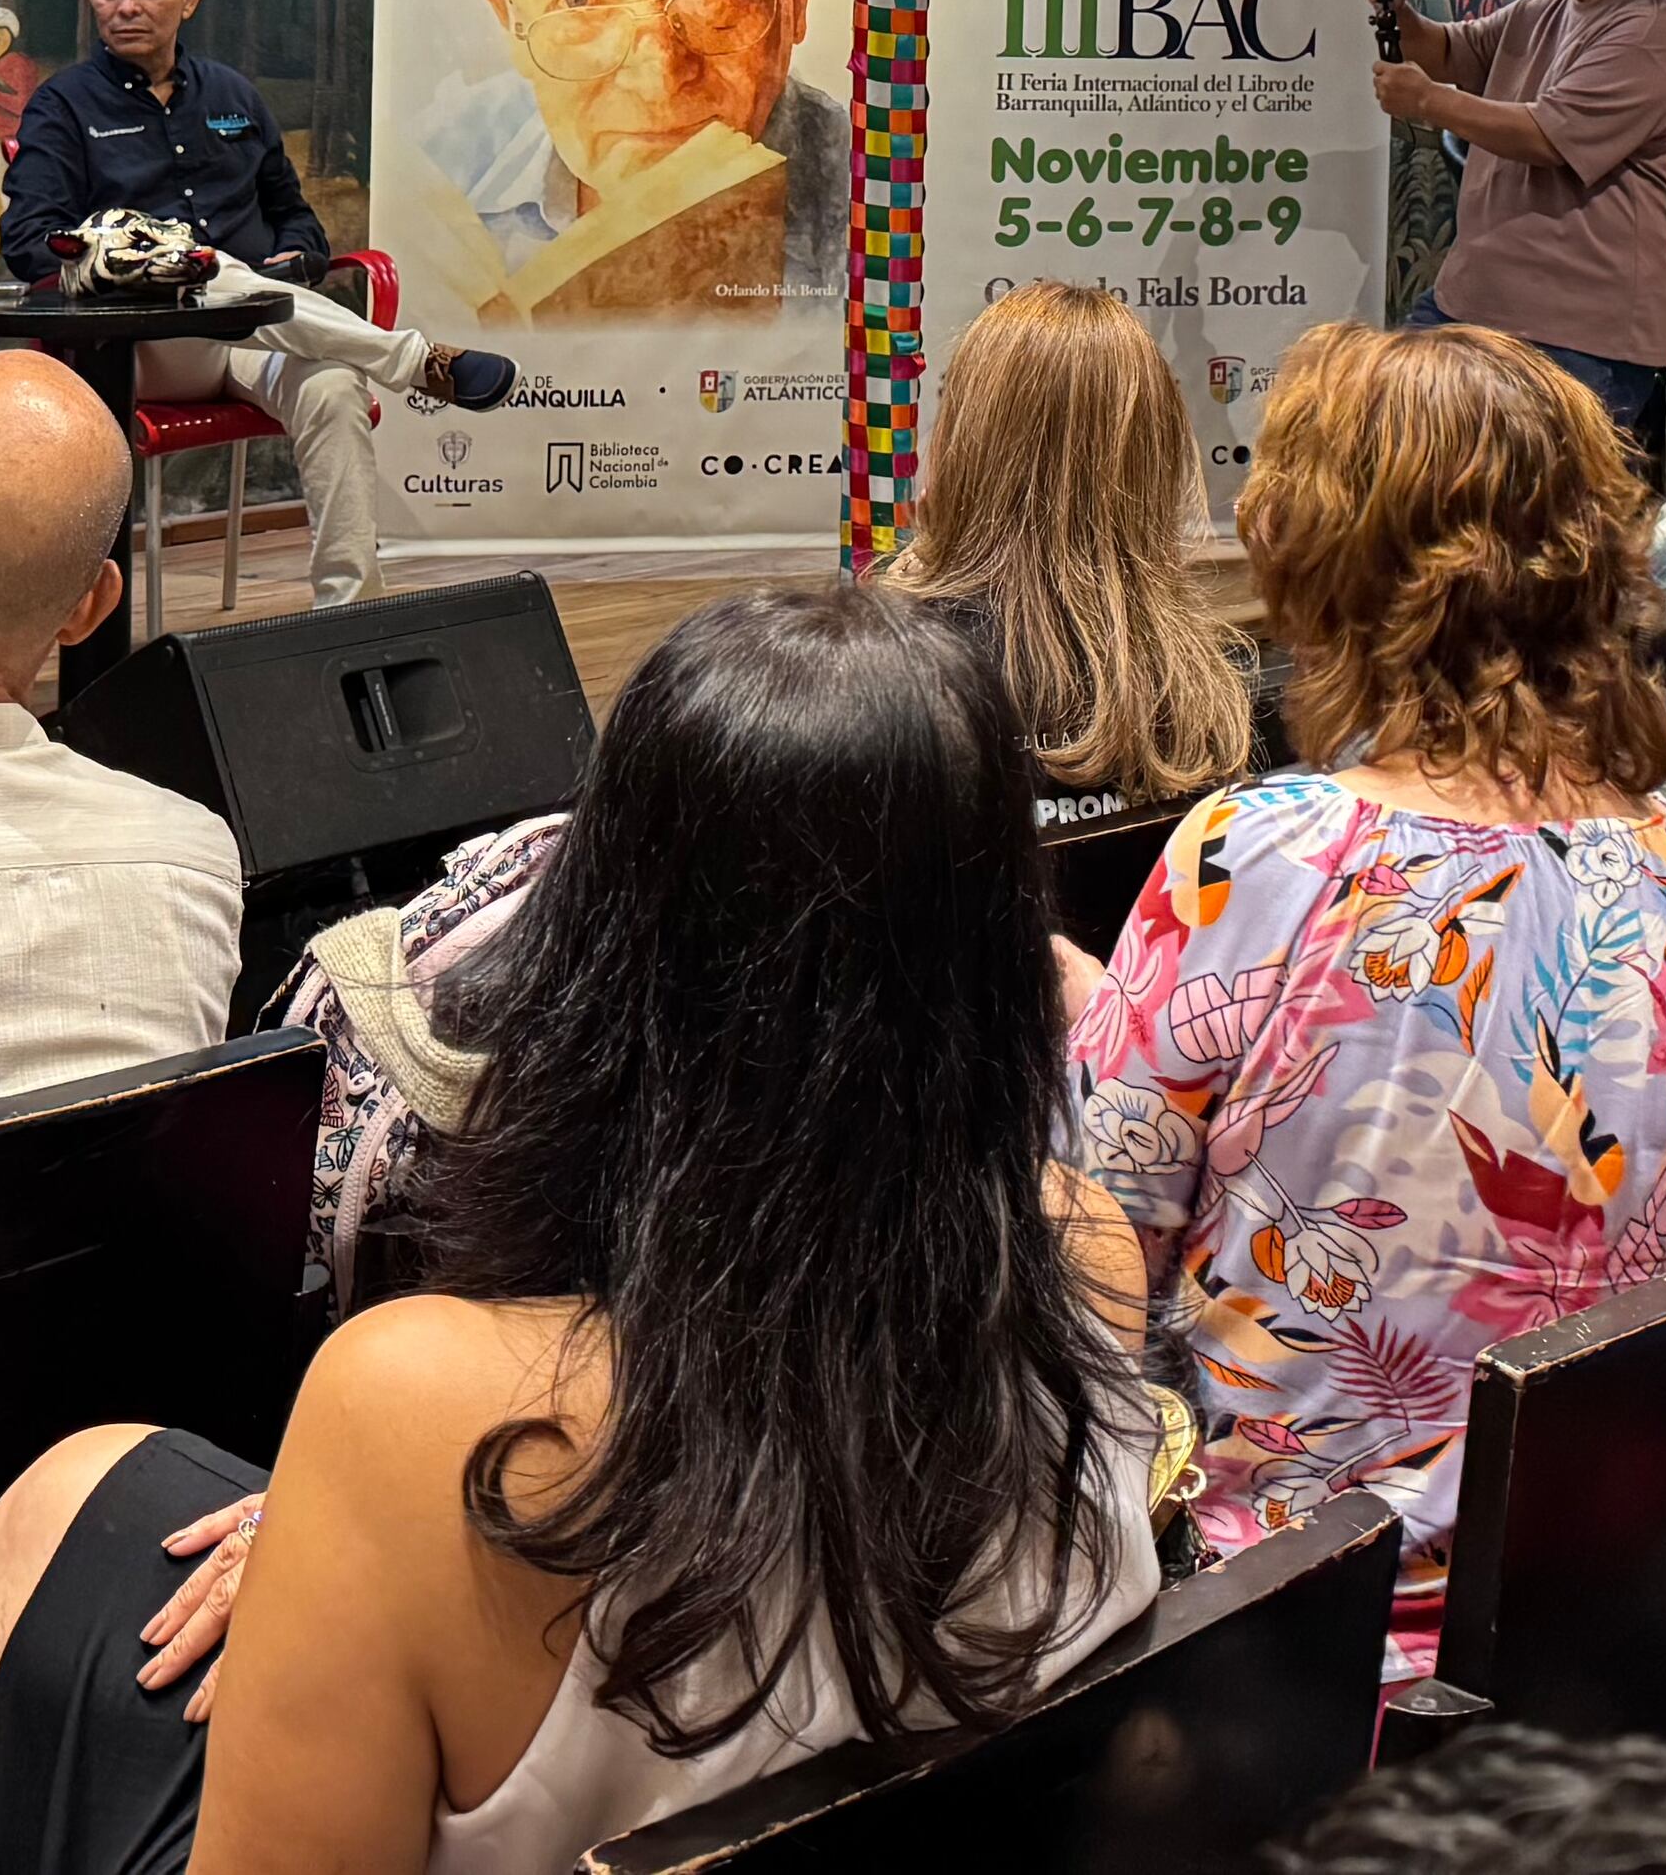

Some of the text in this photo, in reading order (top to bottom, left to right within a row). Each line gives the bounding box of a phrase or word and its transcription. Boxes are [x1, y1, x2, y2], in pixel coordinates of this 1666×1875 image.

[997, 73, 1314, 94] II Feria Internacional del Libro de
[996, 93, 1313, 118] Barranquilla, Atlántico y el Caribe
[990, 133, 1310, 185] Noviembre
[994, 195, 1302, 248] 5-6-7-8-9
[715, 283, 838, 298] Orlando Fals Borda
[1137, 276, 1200, 308] Fals
[1208, 275, 1308, 307] Borda
[535, 375, 554, 389] DE
[743, 373, 824, 386] GOBERNACIÓN
[501, 389, 626, 408] ANQUILLA
[590, 442, 660, 457] Biblioteca
[589, 457, 669, 473] Nacional de
[404, 474, 503, 494] Culturas
[589, 475, 658, 490] Colombia
